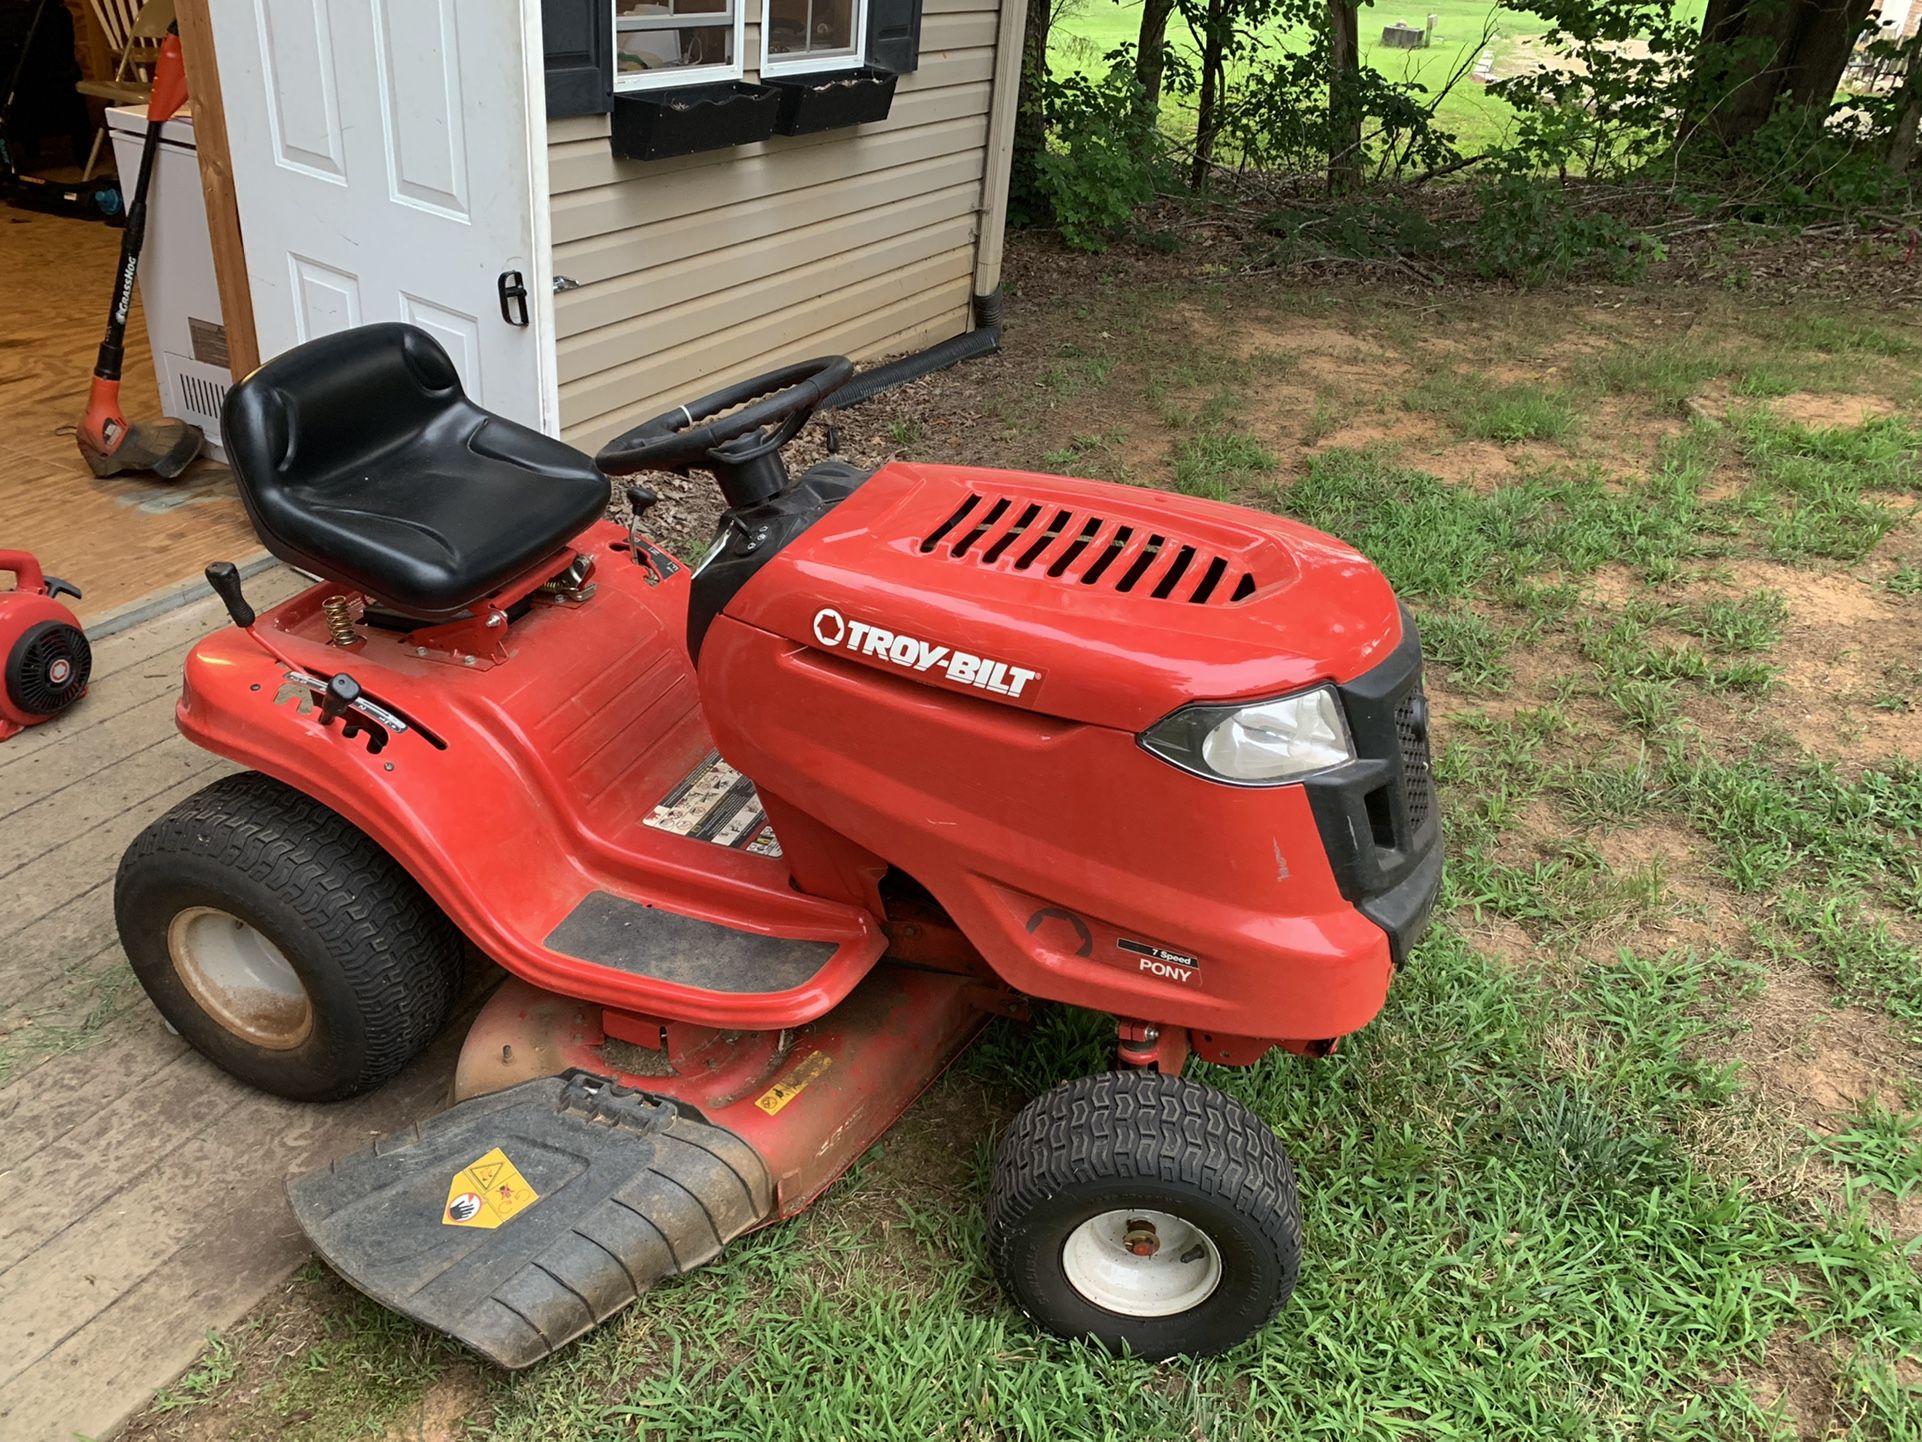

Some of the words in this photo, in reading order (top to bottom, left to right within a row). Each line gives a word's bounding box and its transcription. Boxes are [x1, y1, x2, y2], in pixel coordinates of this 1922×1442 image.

[847, 620, 1036, 698] TROY-BILT
[1152, 948, 1159, 956] 7
[1160, 950, 1191, 965] Speed
[1139, 958, 1192, 982] PONY
